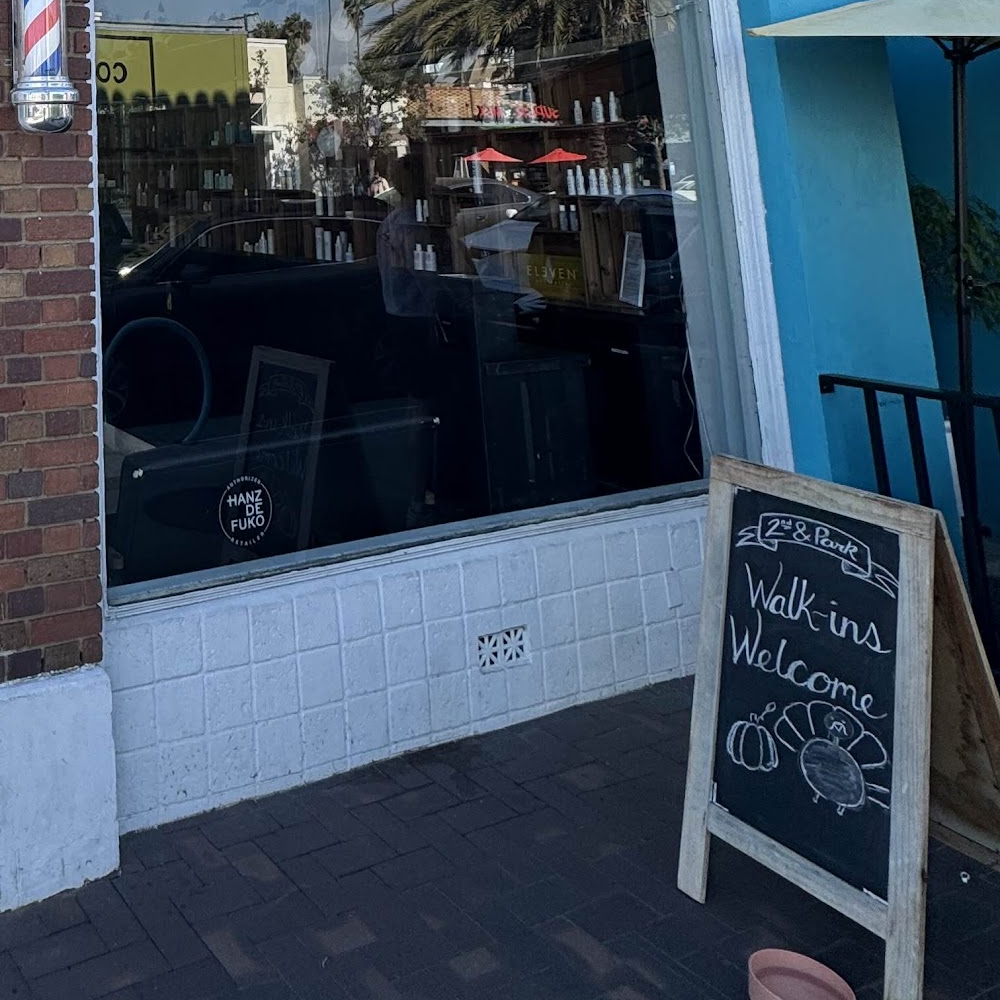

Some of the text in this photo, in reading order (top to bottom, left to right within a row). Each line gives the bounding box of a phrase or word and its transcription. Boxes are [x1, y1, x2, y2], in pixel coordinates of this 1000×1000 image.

[227, 489, 263, 507] HANZ
[246, 502, 264, 517] DE
[231, 515, 265, 532] FUKO
[764, 518, 858, 562] 2nd & Park
[745, 561, 892, 654] Walk-ins
[730, 609, 888, 719] Welcome
